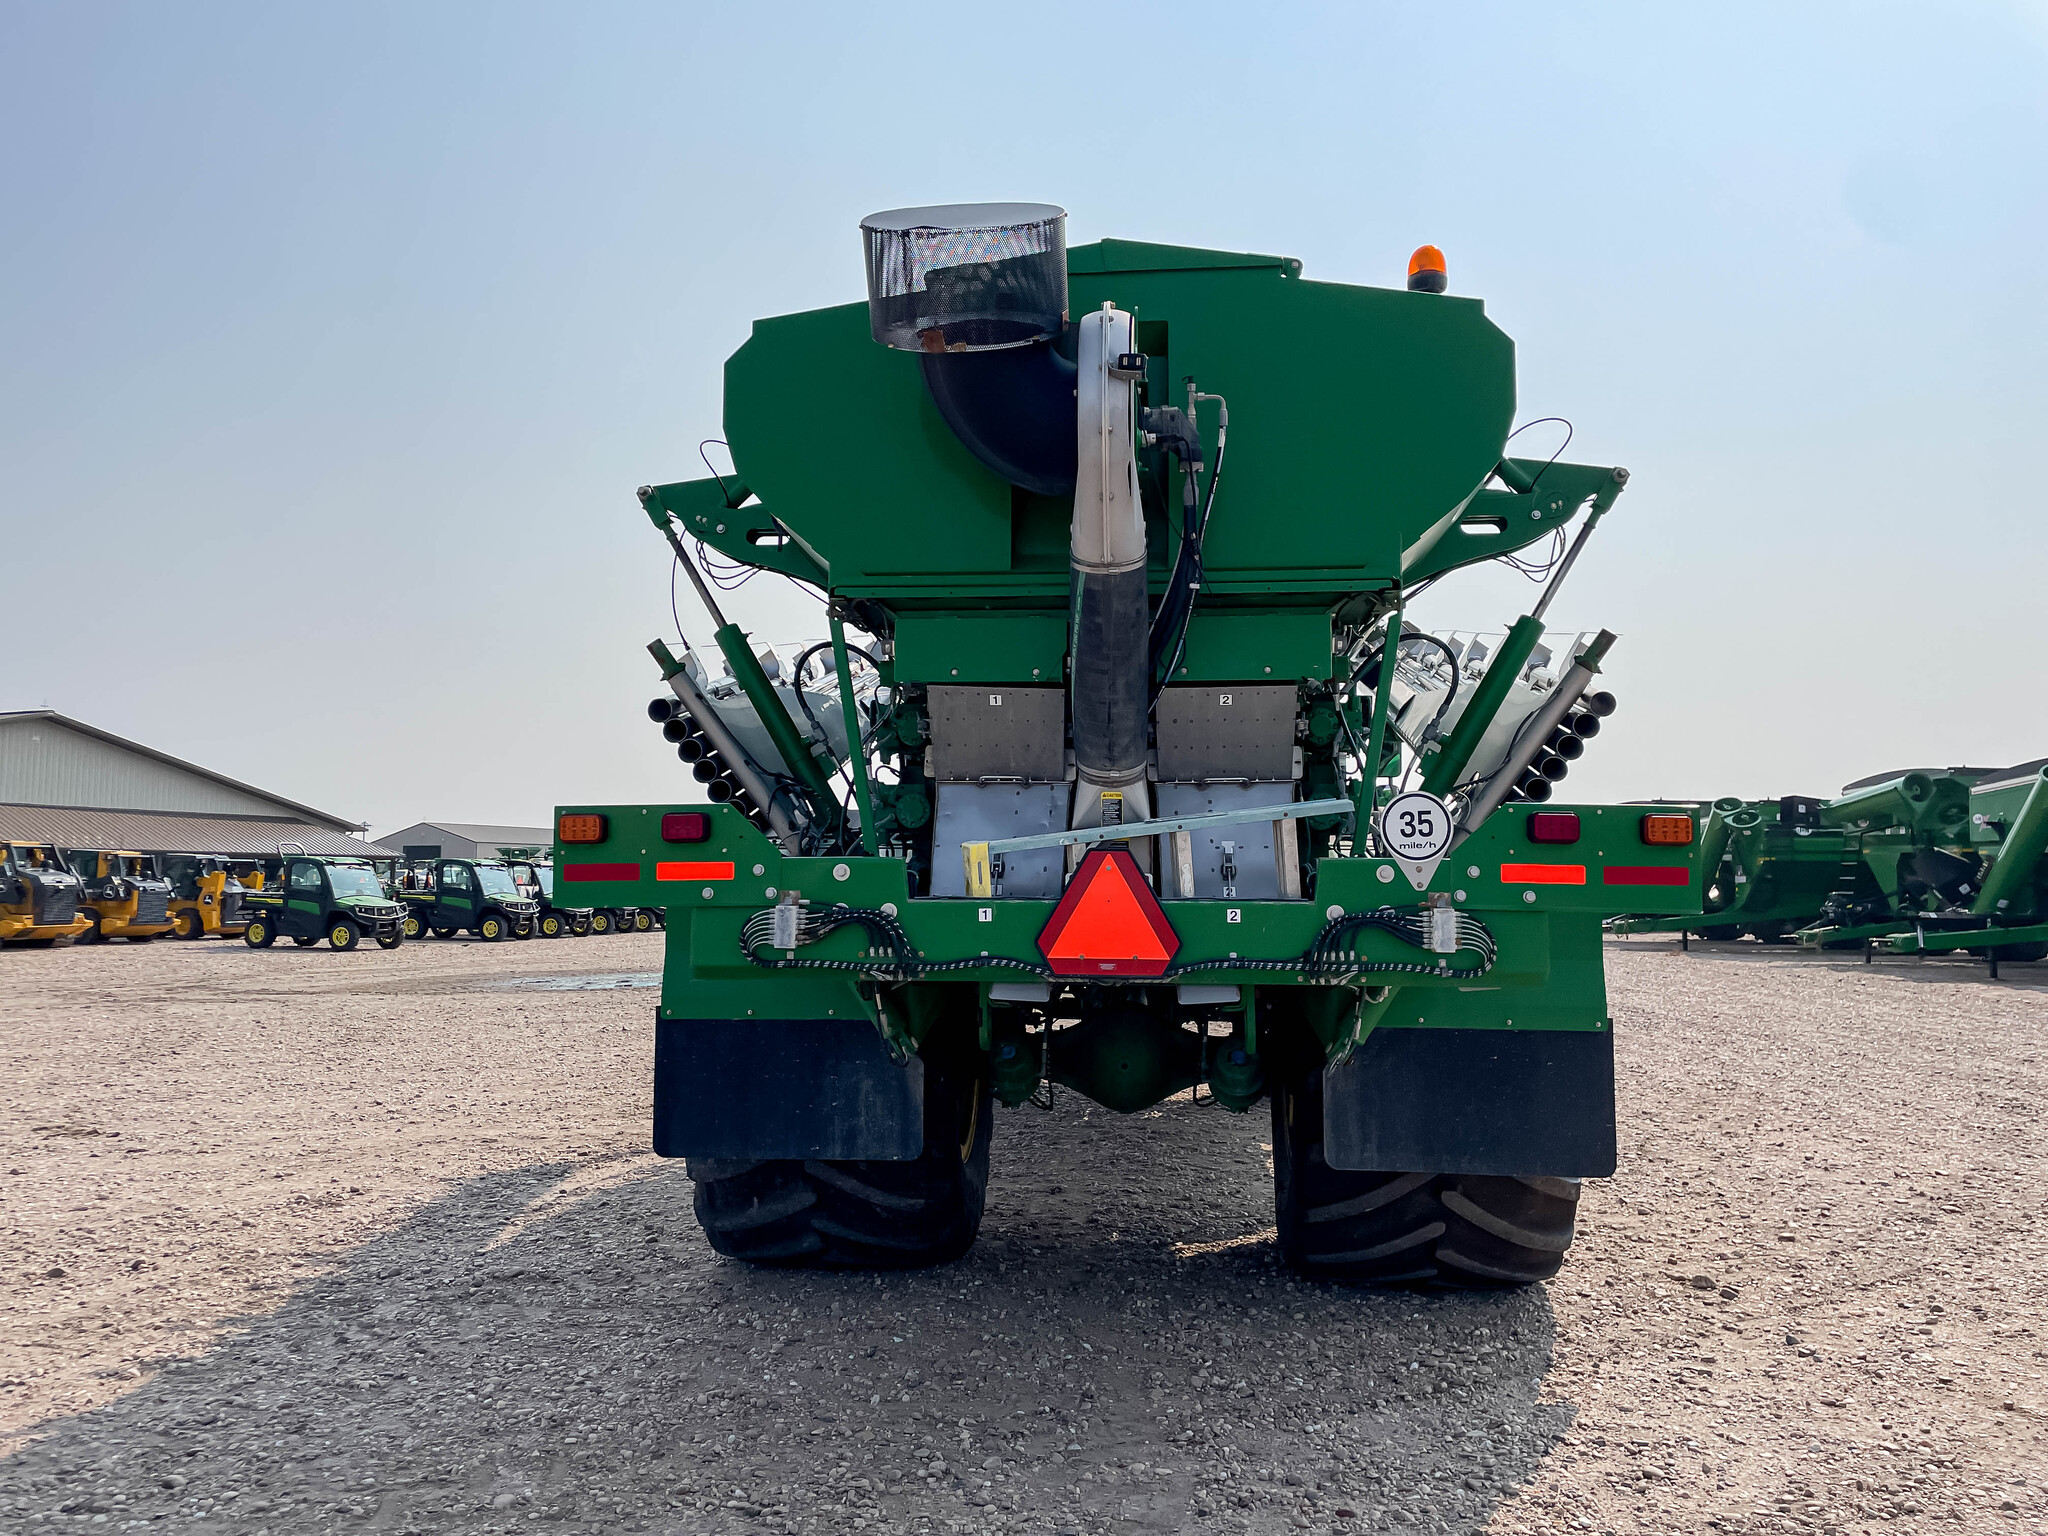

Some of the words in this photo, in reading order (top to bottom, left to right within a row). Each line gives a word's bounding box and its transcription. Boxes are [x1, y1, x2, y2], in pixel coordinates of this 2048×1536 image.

[1222, 695, 1230, 705] 2
[1399, 810, 1433, 837] 35
[1399, 841, 1436, 849] mile/h
[1230, 910, 1238, 921] 2
